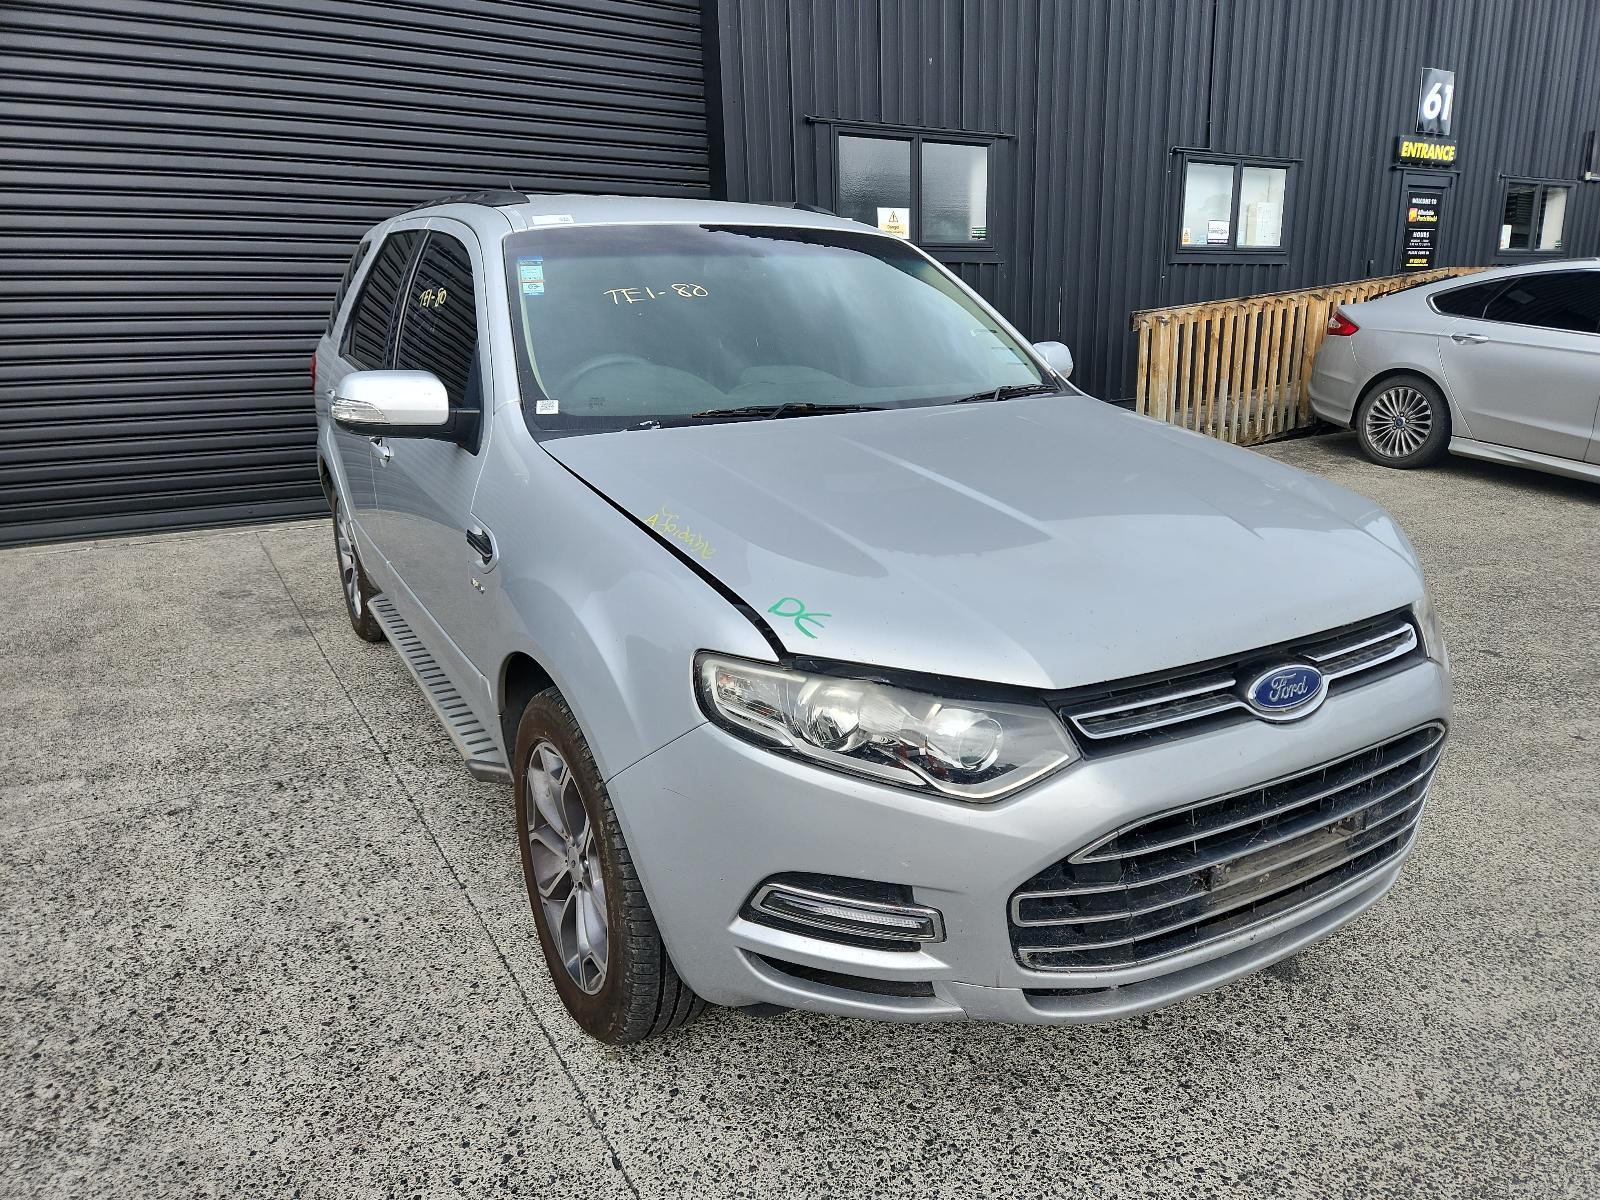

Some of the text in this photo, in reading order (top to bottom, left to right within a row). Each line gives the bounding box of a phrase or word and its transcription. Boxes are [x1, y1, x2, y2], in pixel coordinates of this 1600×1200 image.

[1423, 82, 1454, 121] 61
[1400, 141, 1456, 161] ENTRANCE
[767, 596, 832, 640] DE
[1269, 672, 1309, 703] Ford
